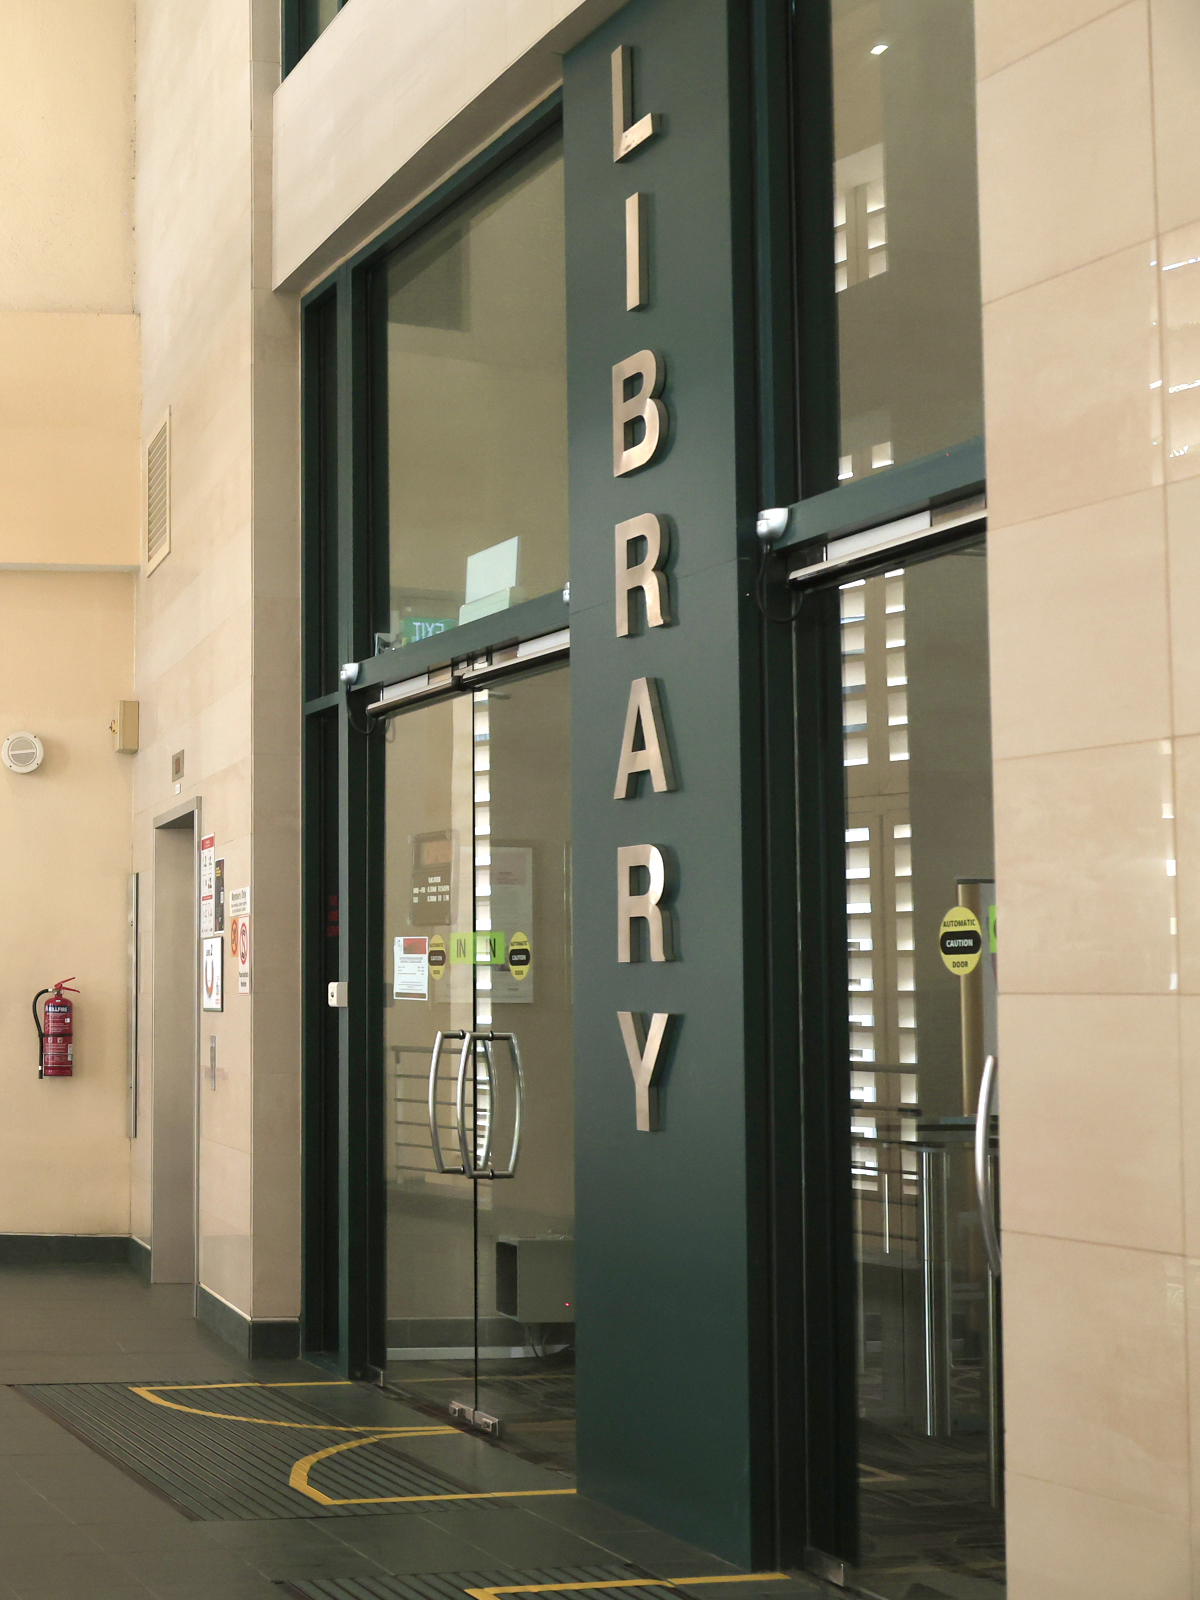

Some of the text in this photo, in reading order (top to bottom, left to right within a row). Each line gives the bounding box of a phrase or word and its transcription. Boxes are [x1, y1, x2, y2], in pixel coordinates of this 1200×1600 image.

[611, 44, 677, 1133] LIBRARY
[943, 919, 976, 927] AUTOMATIC
[946, 939, 973, 947] CAUTION
